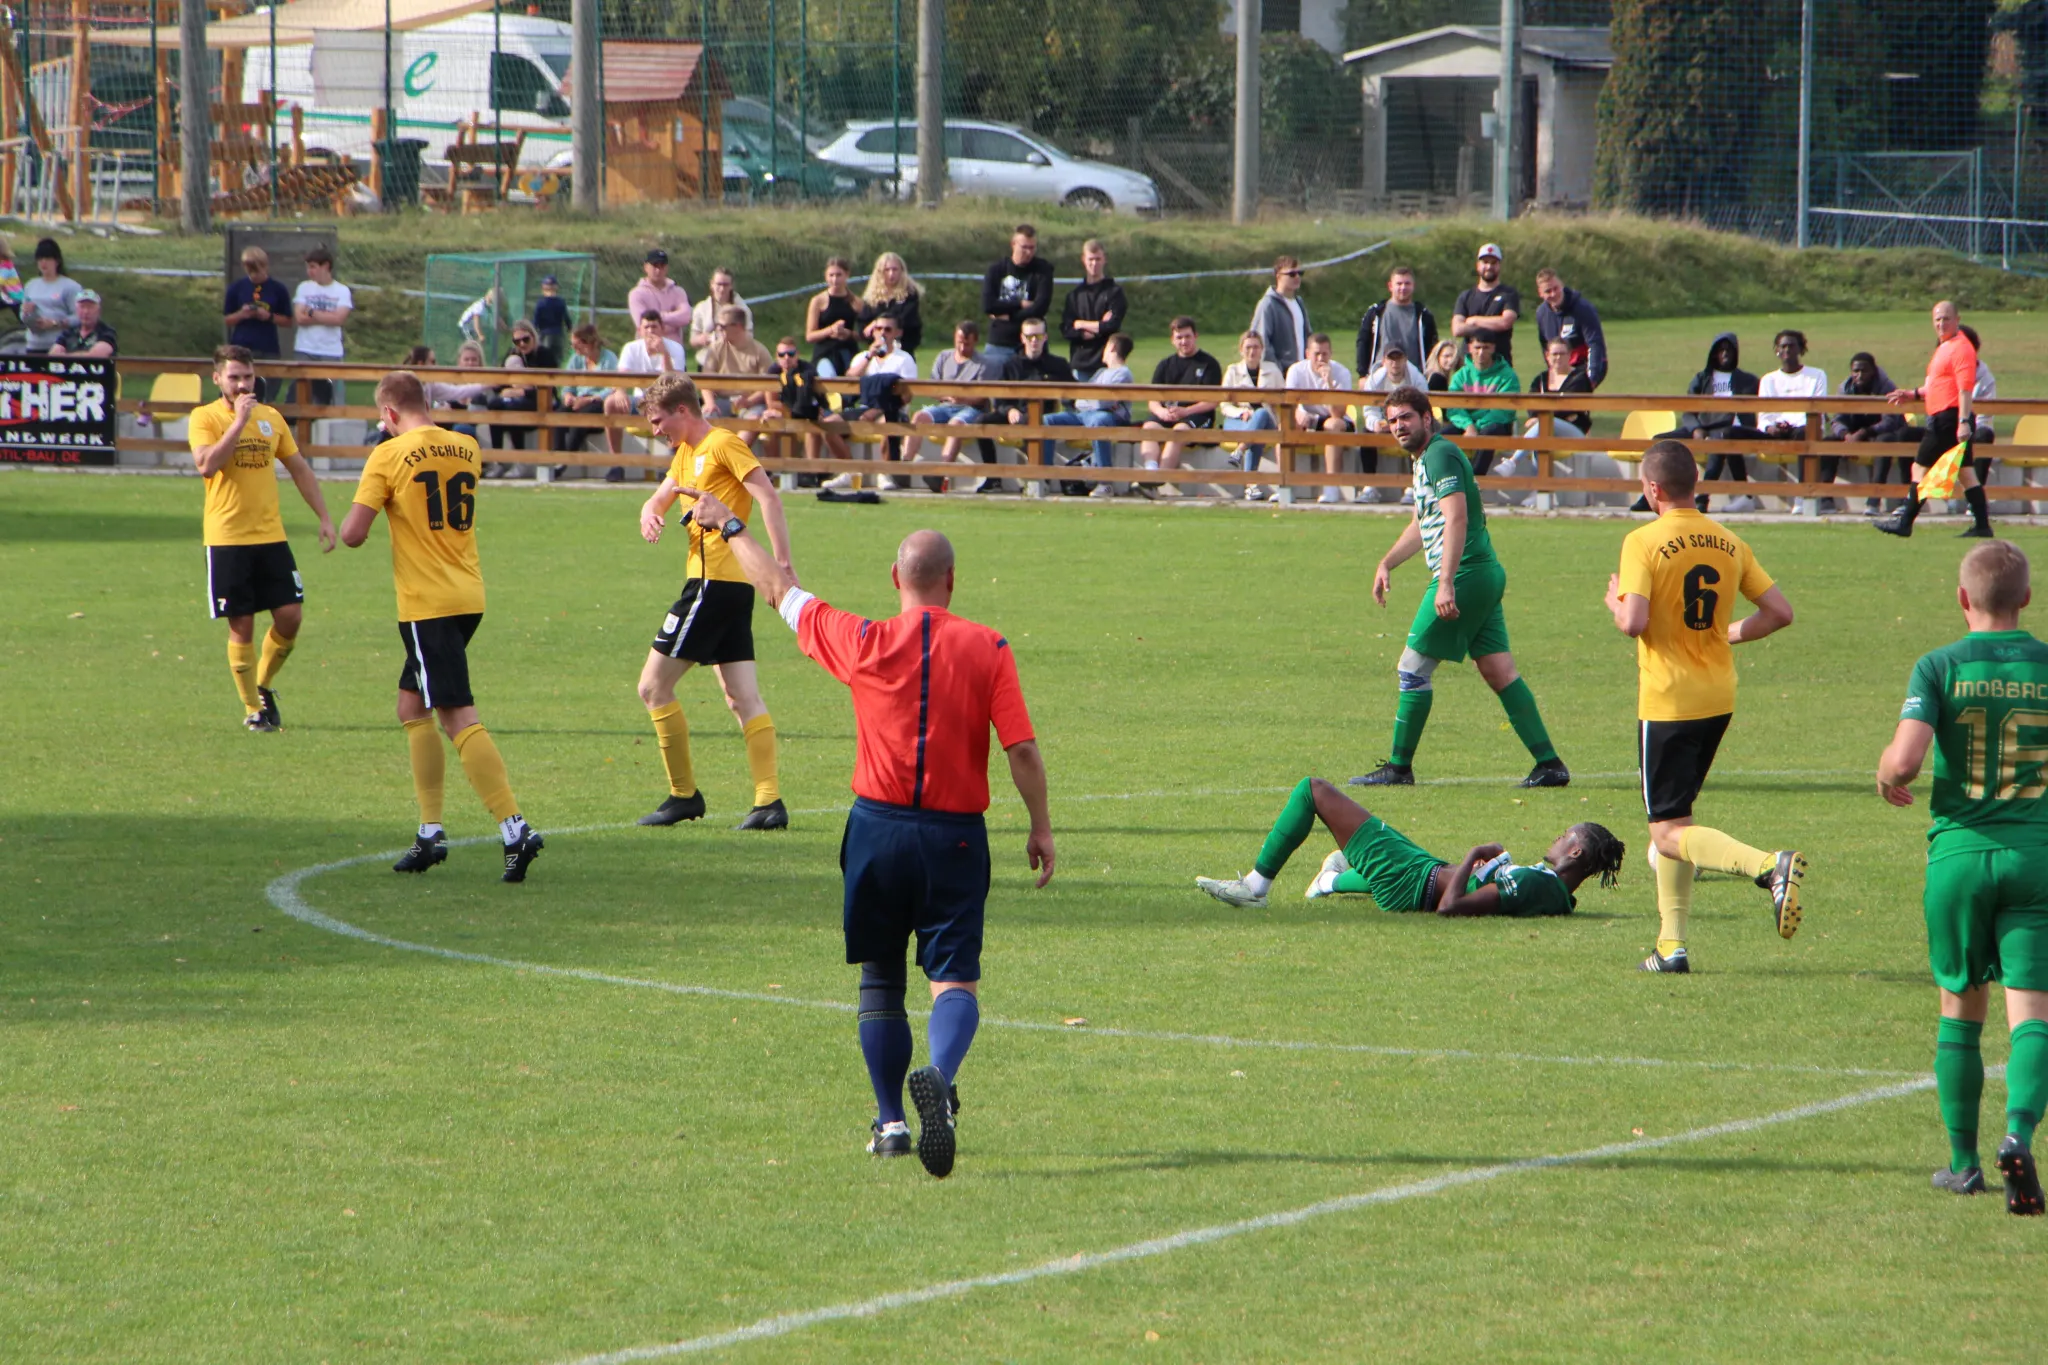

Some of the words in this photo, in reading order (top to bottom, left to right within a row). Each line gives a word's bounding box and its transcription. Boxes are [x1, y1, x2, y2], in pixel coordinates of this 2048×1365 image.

[235, 460, 270, 469] LIPPOLD
[404, 447, 428, 467] FSV
[429, 445, 474, 463] SCHLEIZ
[413, 470, 476, 531] 16
[1660, 536, 1686, 559] FSV
[1689, 534, 1736, 557] SCHLEIZ
[217, 598, 227, 612] 7
[1683, 563, 1720, 630] 6
[1954, 706, 2048, 800] 16
